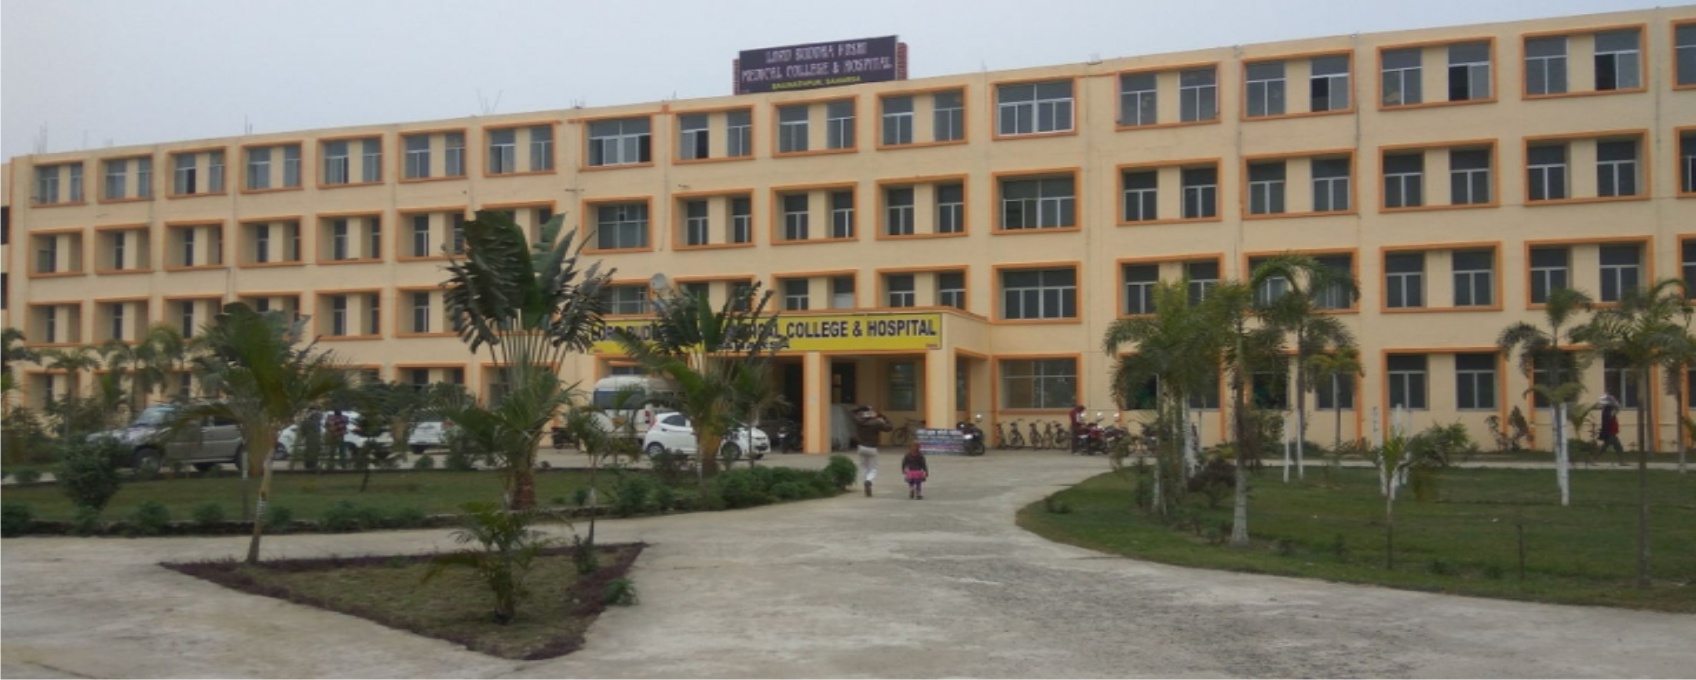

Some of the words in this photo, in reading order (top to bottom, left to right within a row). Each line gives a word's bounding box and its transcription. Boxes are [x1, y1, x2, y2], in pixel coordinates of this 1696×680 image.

[764, 49, 792, 64] LORD
[795, 45, 834, 61] BUDDHA
[741, 67, 783, 83] MEDICAL
[786, 61, 829, 78] COLLEGE
[843, 56, 893, 73] HOSPITAL
[786, 321, 848, 338] COLLEGE
[852, 321, 863, 337] &
[866, 319, 936, 337] HOSPITAL
